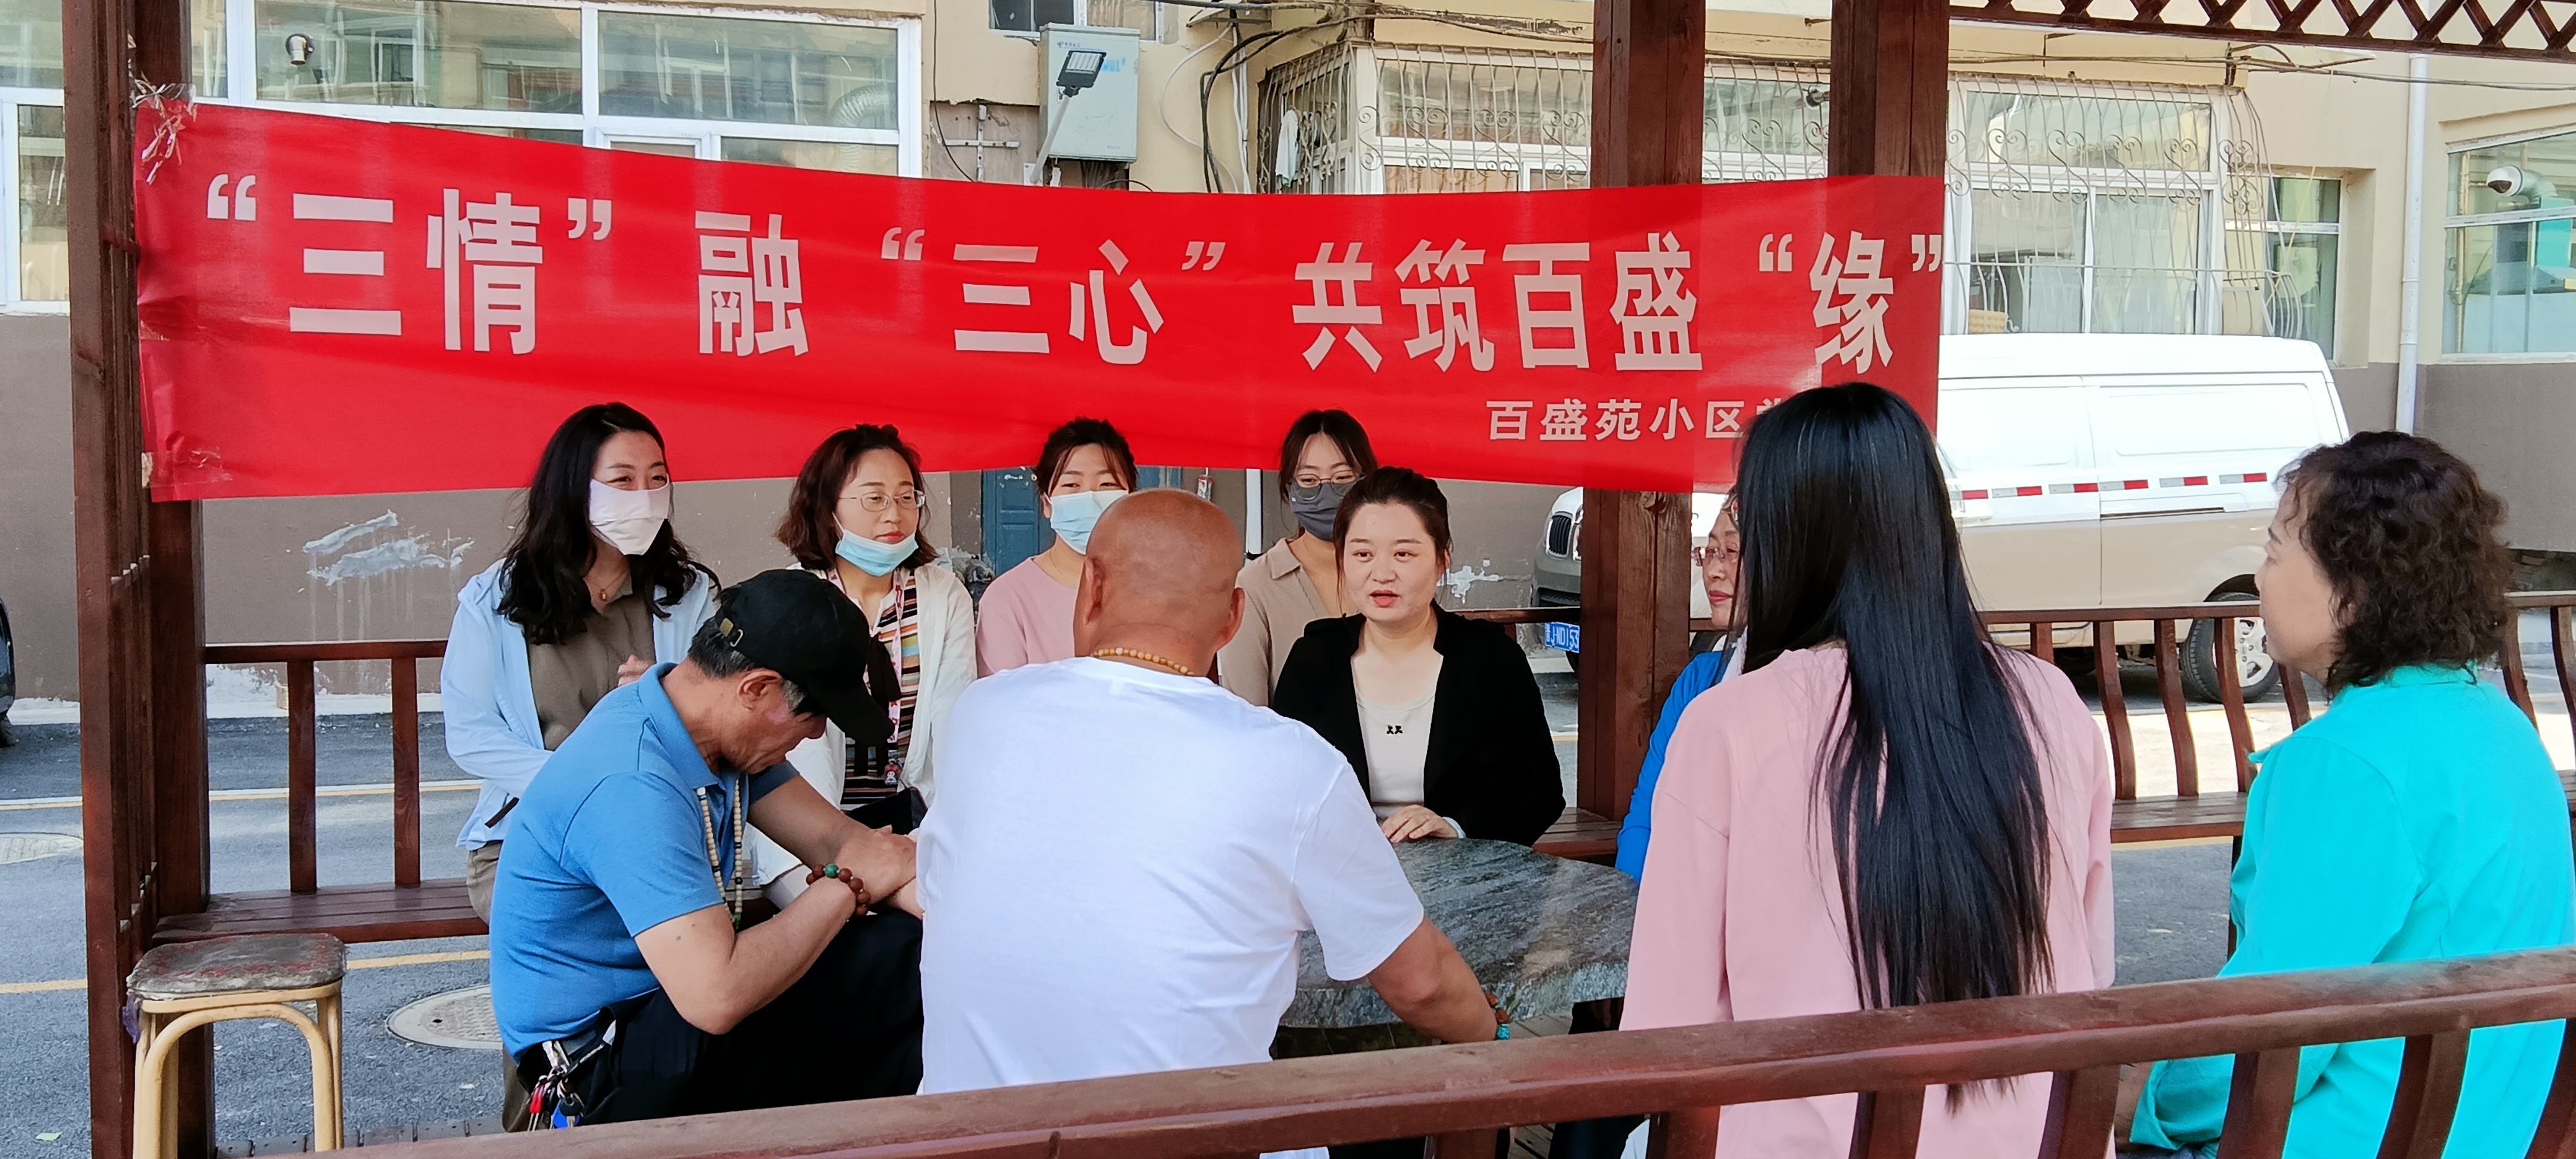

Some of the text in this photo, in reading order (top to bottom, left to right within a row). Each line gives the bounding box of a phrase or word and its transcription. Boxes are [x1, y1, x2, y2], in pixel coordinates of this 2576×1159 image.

[1486, 397, 1782, 441] 百盛苑小区
